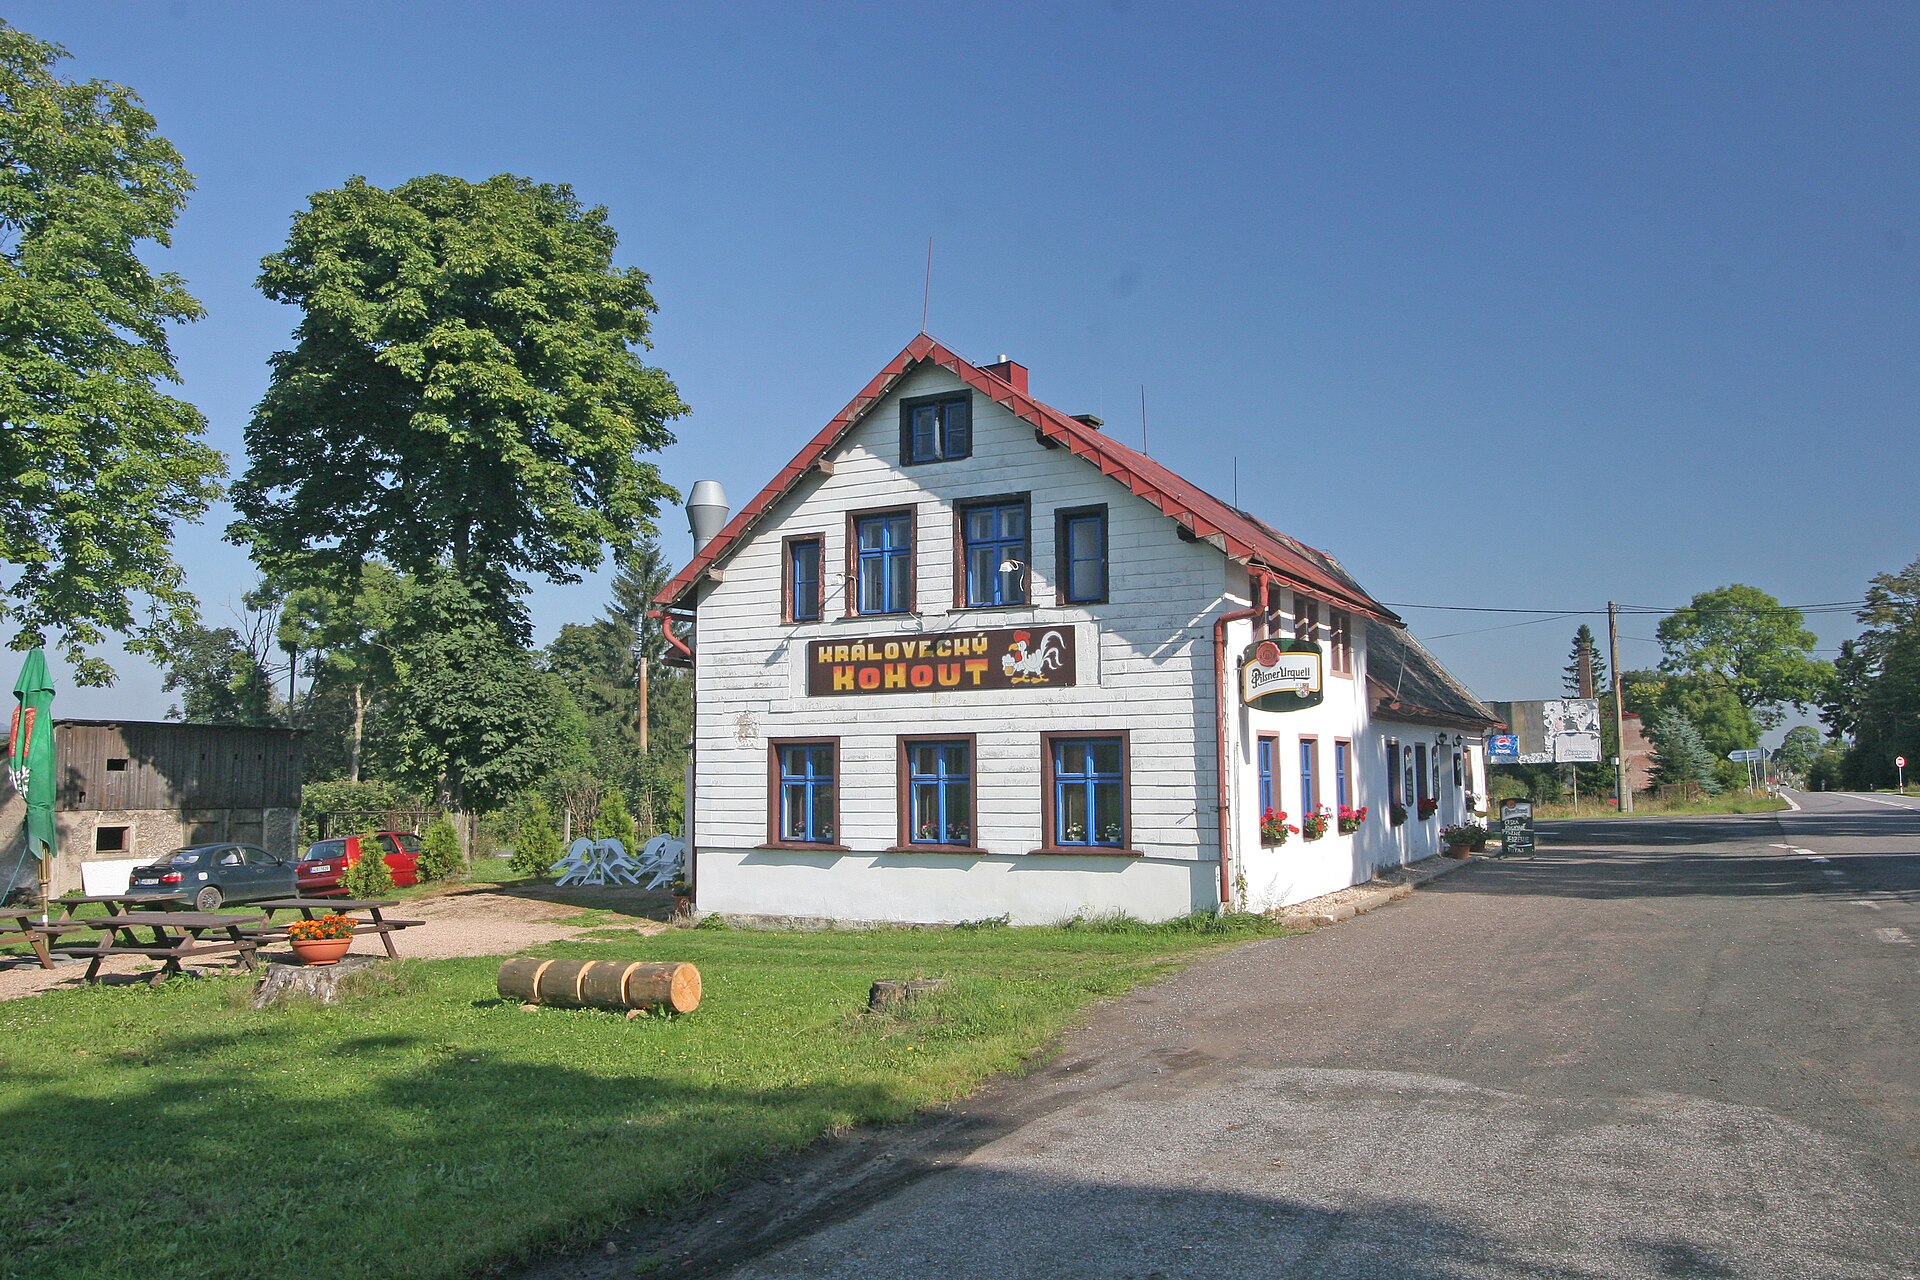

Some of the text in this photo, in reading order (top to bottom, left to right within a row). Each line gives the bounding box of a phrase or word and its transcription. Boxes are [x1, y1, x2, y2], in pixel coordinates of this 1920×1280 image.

[818, 632, 988, 664] KRÁLOVECKÝ
[832, 658, 989, 691] KOHOUT
[1251, 666, 1310, 689] Pilsner Urquell
